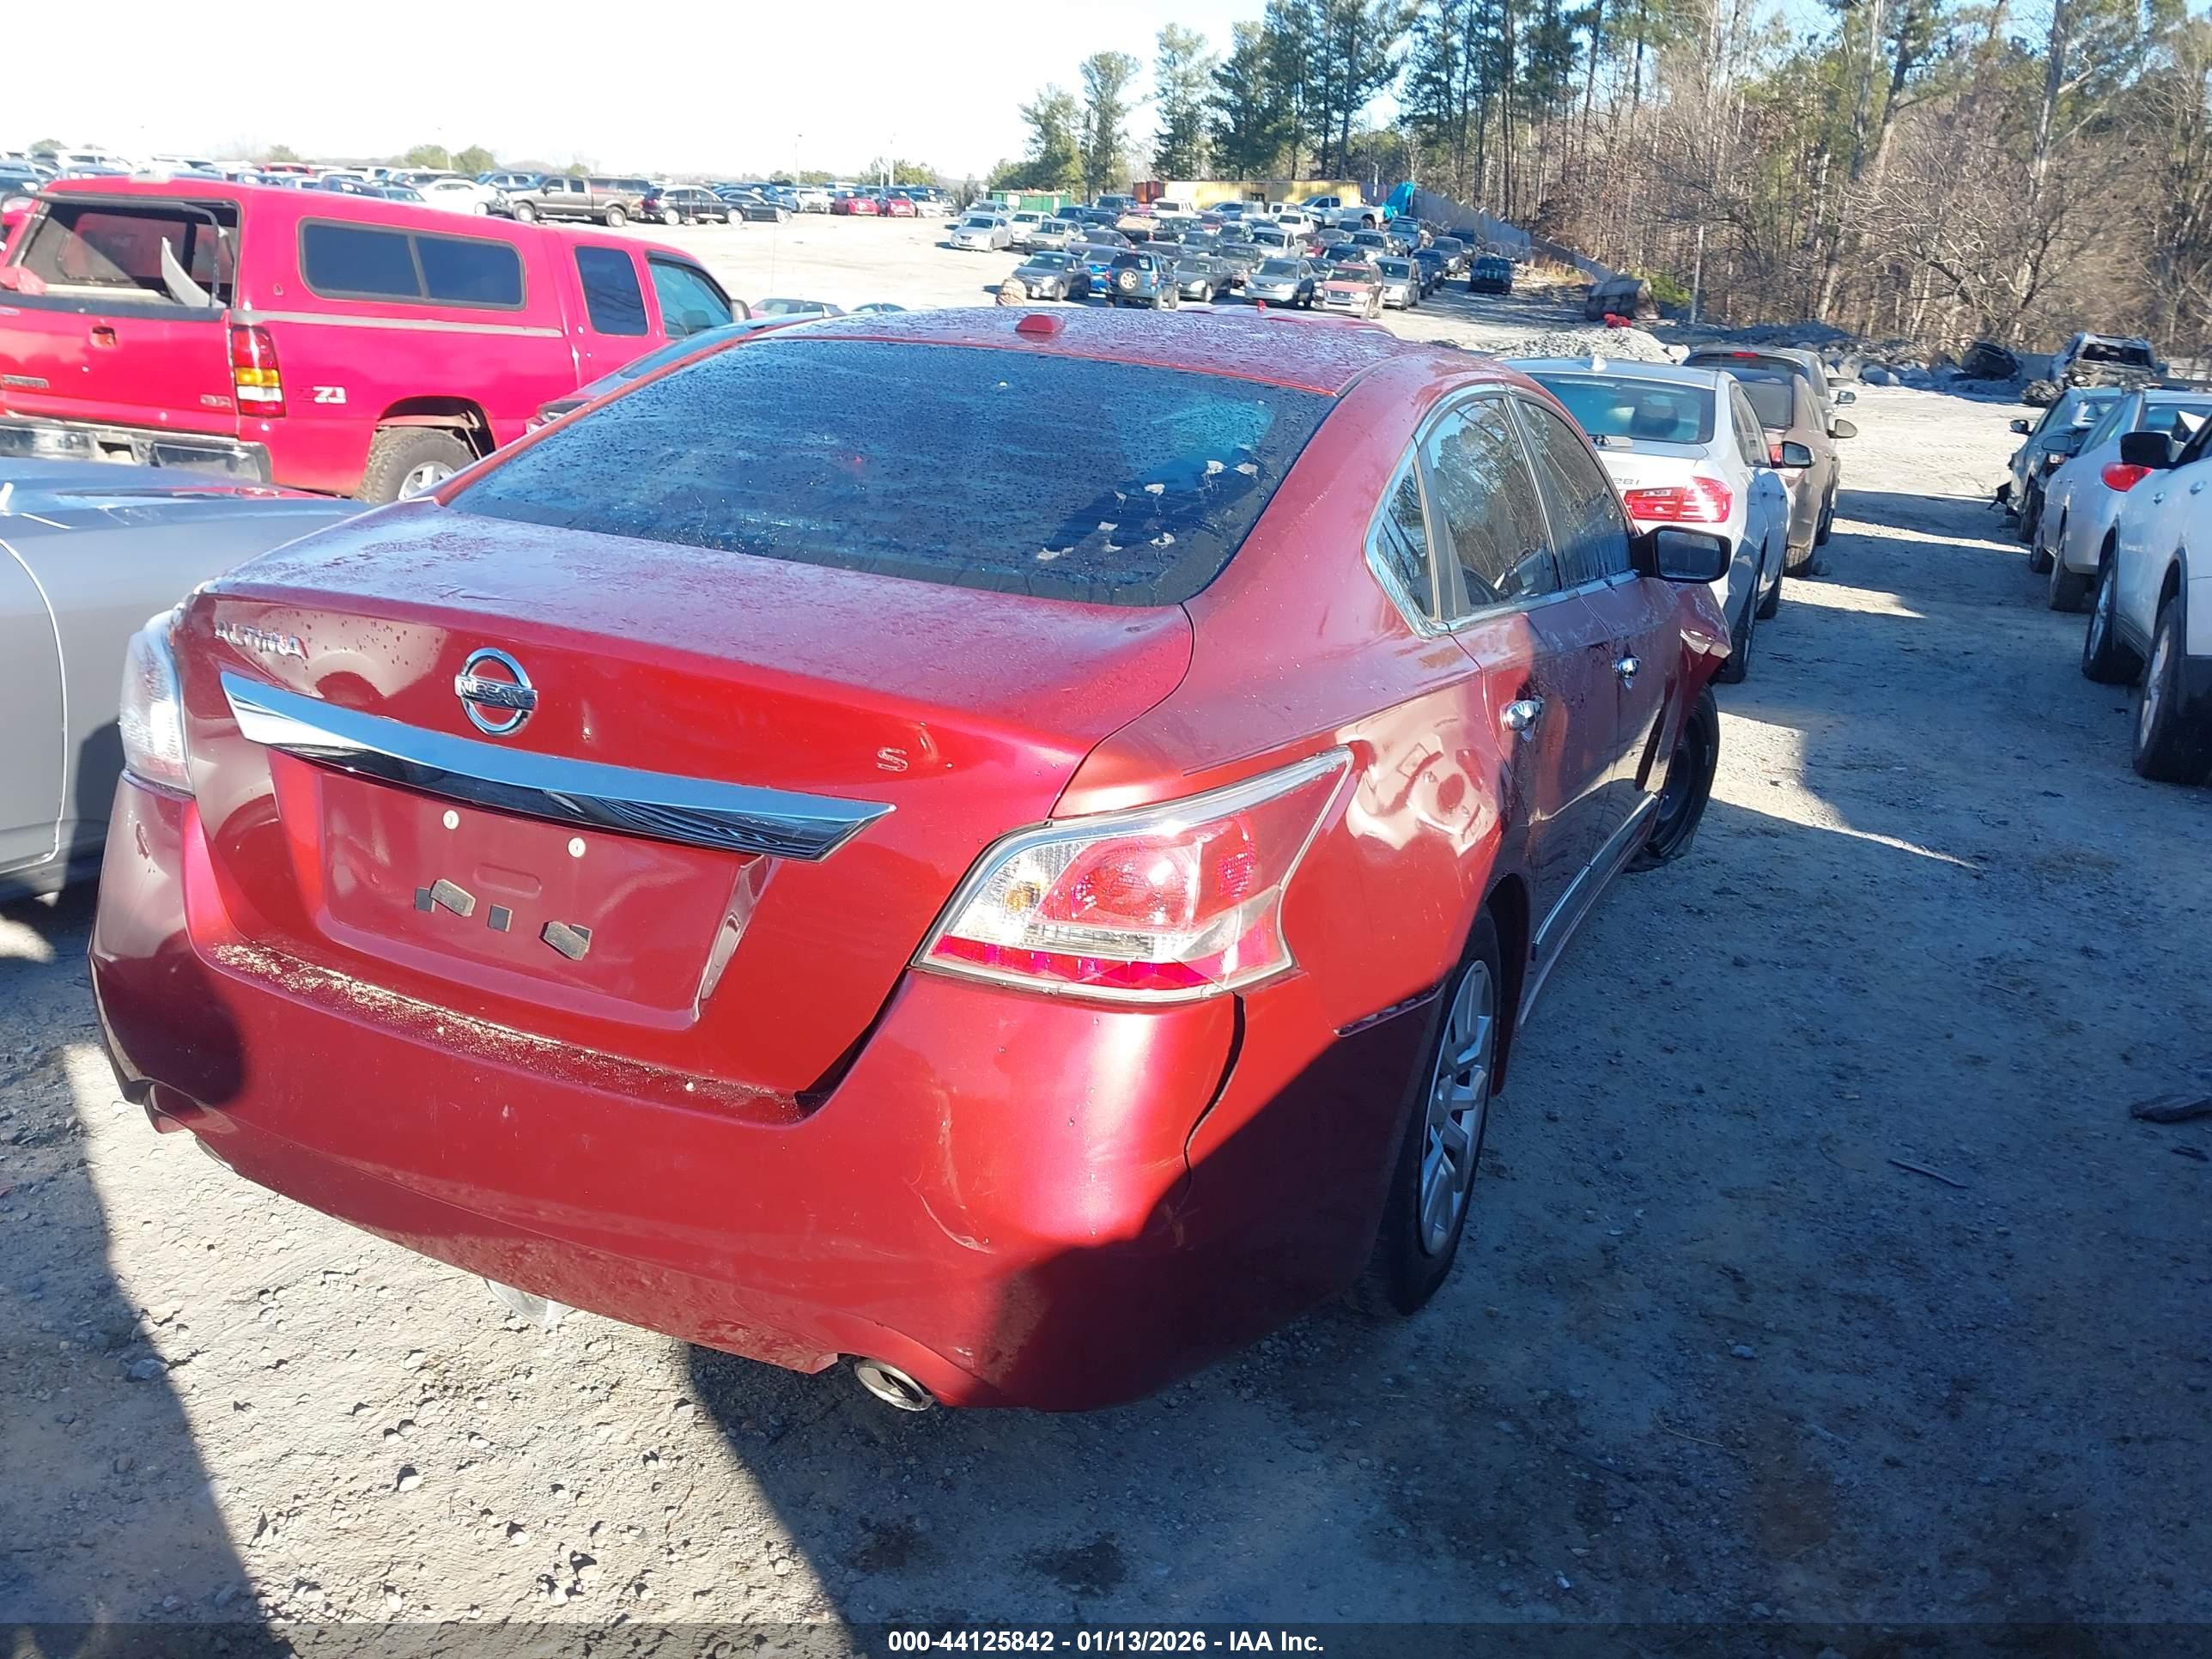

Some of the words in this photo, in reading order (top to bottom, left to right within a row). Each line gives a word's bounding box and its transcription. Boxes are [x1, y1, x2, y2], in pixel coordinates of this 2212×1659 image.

[214, 619, 309, 660] ALTIMA
[460, 679, 534, 708] NISSAN
[876, 746, 908, 773] S
